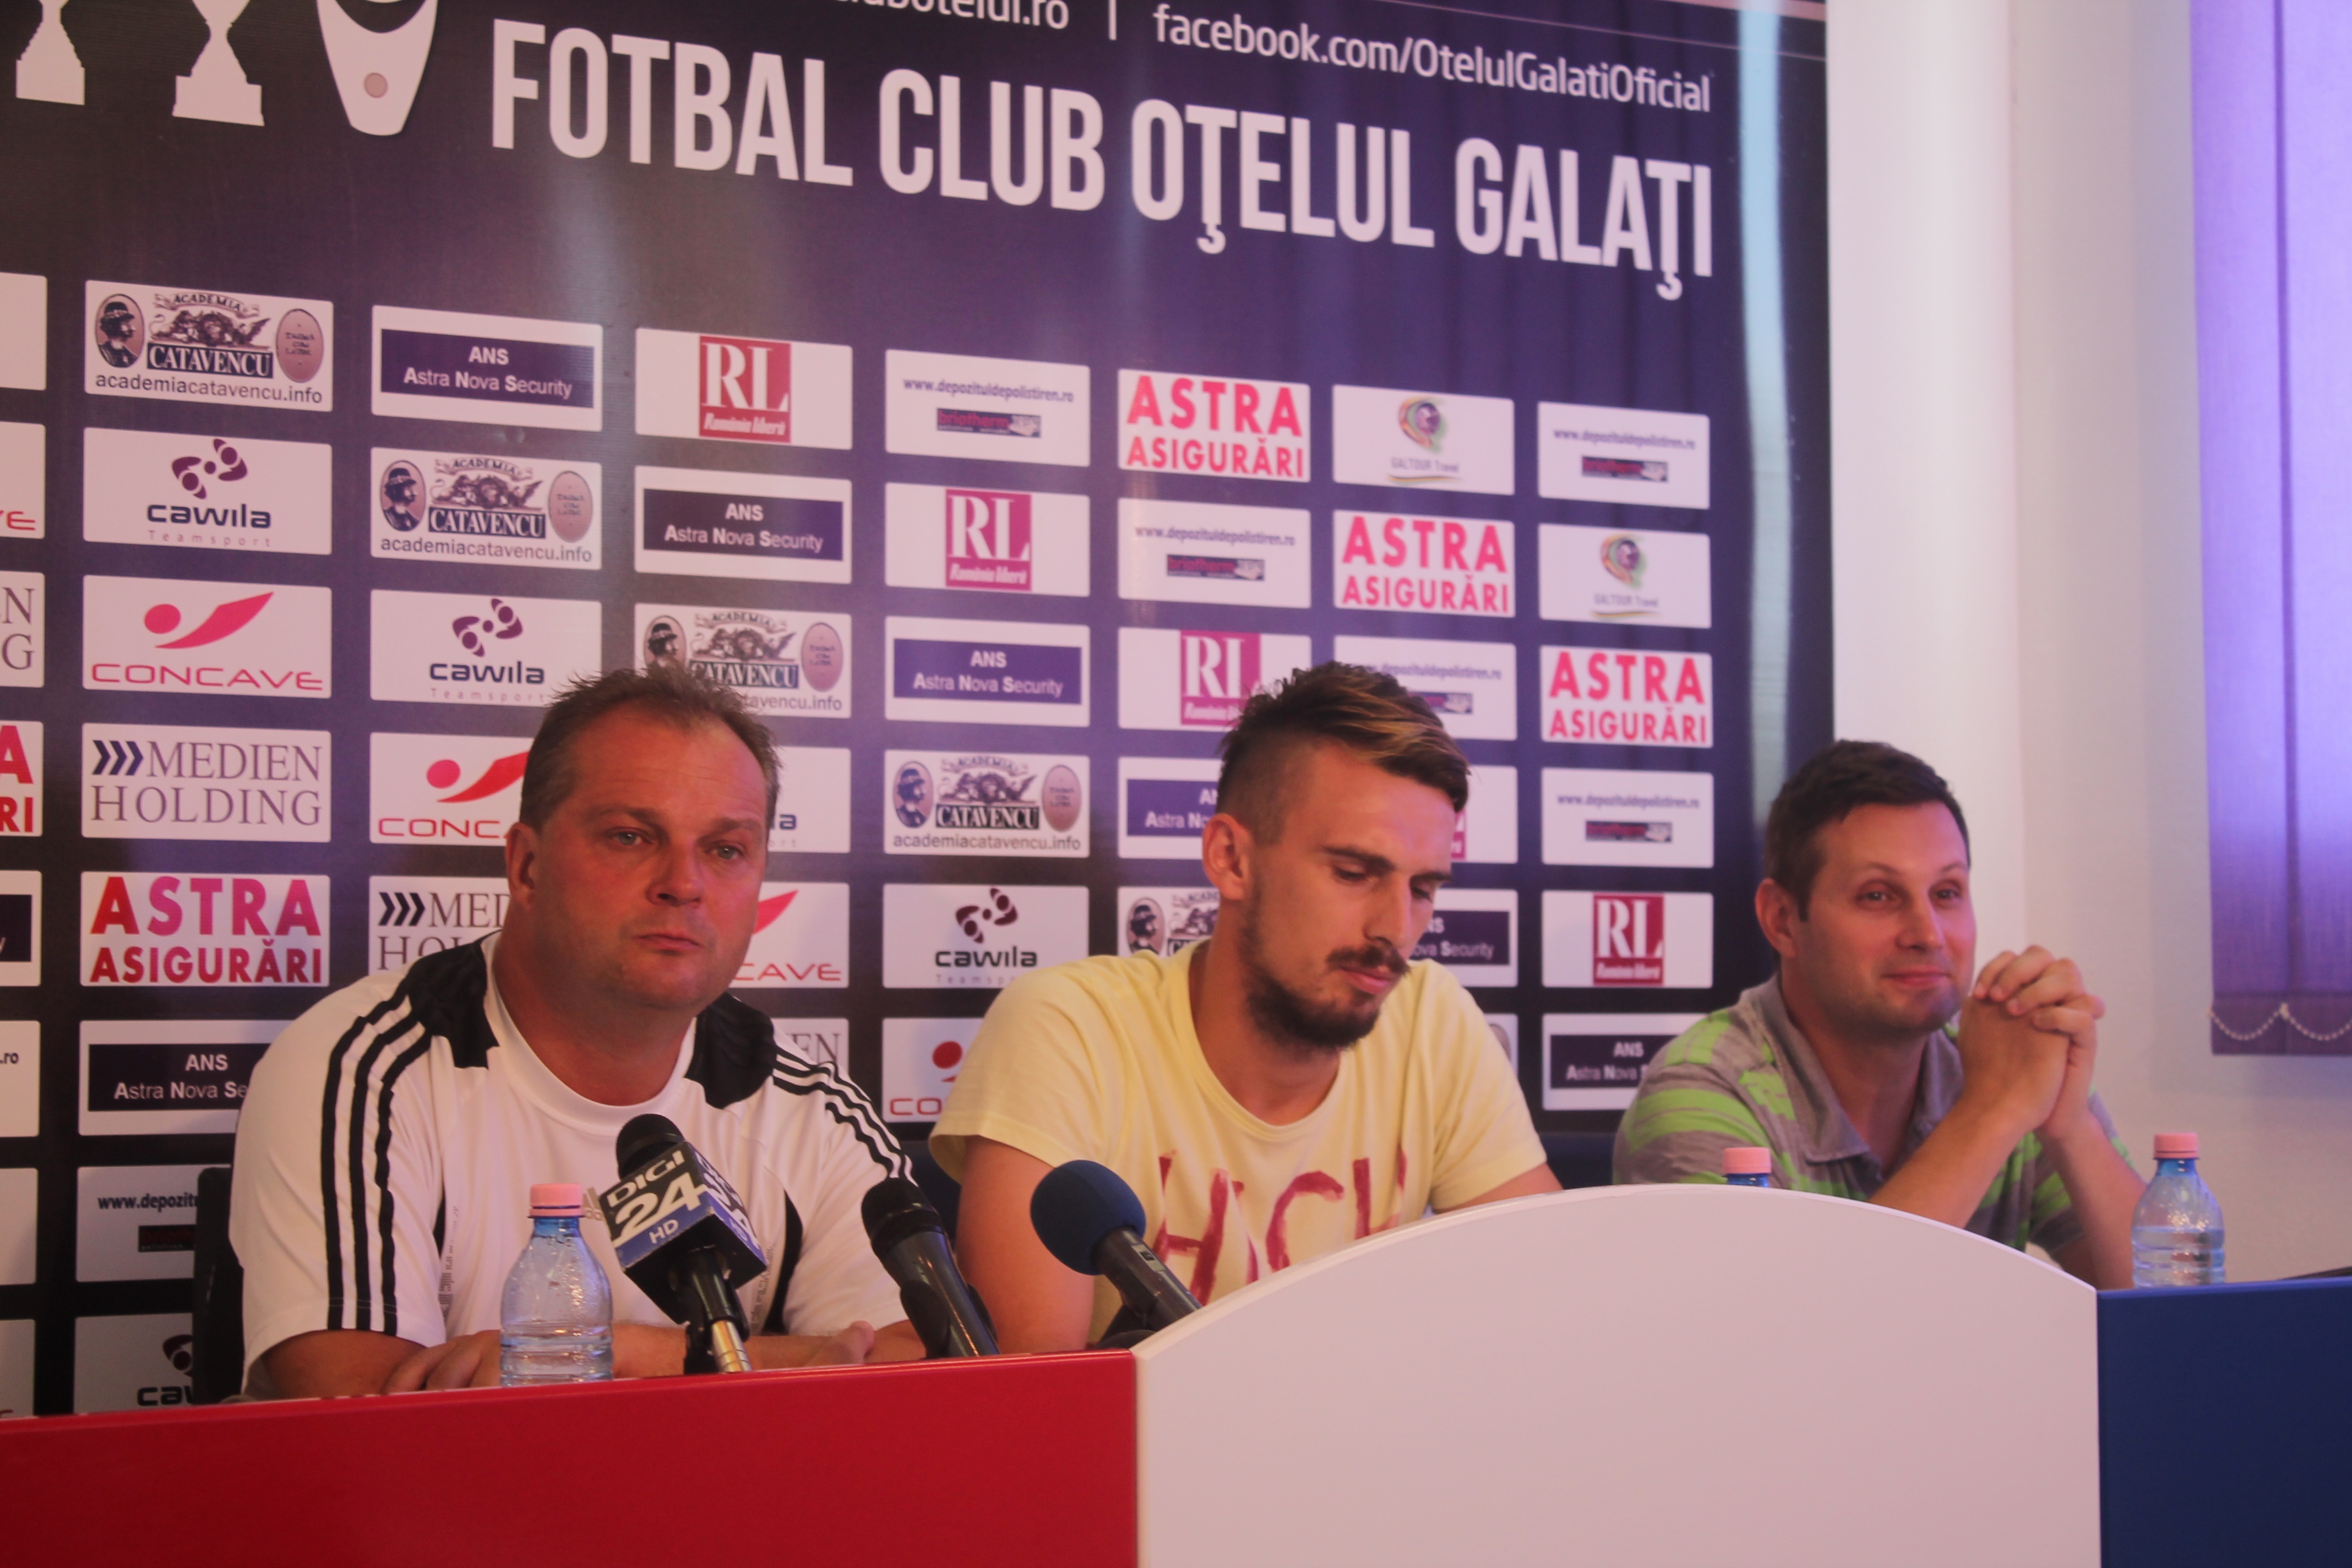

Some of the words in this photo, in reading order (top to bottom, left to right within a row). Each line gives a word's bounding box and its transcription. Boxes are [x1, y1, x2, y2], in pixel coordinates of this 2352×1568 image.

[1153, 3, 1711, 112] facebook.com/OtelulGalatiOficial
[493, 18, 853, 187] FOTBAL
[879, 68, 1104, 211] CLUB
[173, 293, 241, 312] ACADEMIA
[149, 345, 270, 377] CATAVENCU
[469, 346, 509, 365] ANS
[95, 372, 323, 404] academiacatavencu.info
[404, 367, 450, 386] Astra
[455, 371, 499, 391] Nova
[505, 375, 573, 400] Security
[701, 342, 789, 412] RL
[1126, 375, 1303, 437] ASTRA
[453, 458, 516, 475] ACADEMIA
[1126, 437, 1303, 478] ASIGURĂRI
[147, 503, 271, 529] cawila
[431, 510, 543, 537] CATAVENCU
[725, 503, 764, 521] ANS
[148, 530, 271, 548] Teamsport
[664, 525, 708, 543] Astra
[712, 528, 754, 546] Nova
[759, 530, 824, 553] Security
[947, 496, 1030, 562] RL
[380, 537, 592, 562] academiacatavencu.info
[1342, 515, 1507, 573] ASTRA
[1342, 573, 1509, 613] ASIGURĂRI
[429, 661, 545, 684] cawila
[971, 650, 1007, 668] ANS
[92, 663, 323, 691] CONCAVE
[913, 673, 955, 690] Astra
[959, 675, 998, 693] Nova
[1003, 677, 1064, 698] Security
[1549, 651, 1705, 704] ASTRA
[1549, 706, 1706, 742] ASIGURĂRI
[147, 741, 323, 782] MEDIEN
[91, 785, 322, 826] HOLDING
[937, 805, 1038, 829] CATAVENCU
[1145, 810, 1185, 828] Astra
[378, 818, 508, 838] CONC
[893, 834, 1081, 851] academiacatavencu.info
[90, 876, 322, 937] ASTRA
[1597, 899, 1663, 958] RL
[90, 938, 322, 983] ASIGURĂRI
[935, 946, 1037, 967] cawila
[1440, 940, 1495, 960] Security
[186, 1054, 228, 1071] ANS
[1613, 1041, 1645, 1058] ANS
[1566, 1065, 1600, 1081] Astra
[1603, 1065, 1637, 1080] Nova
[114, 1082, 164, 1099] Astra
[171, 1082, 218, 1099] Nova
[606, 1150, 686, 1208] DIGI
[613, 1172, 709, 1248] 24
[649, 1219, 679, 1244] HD
